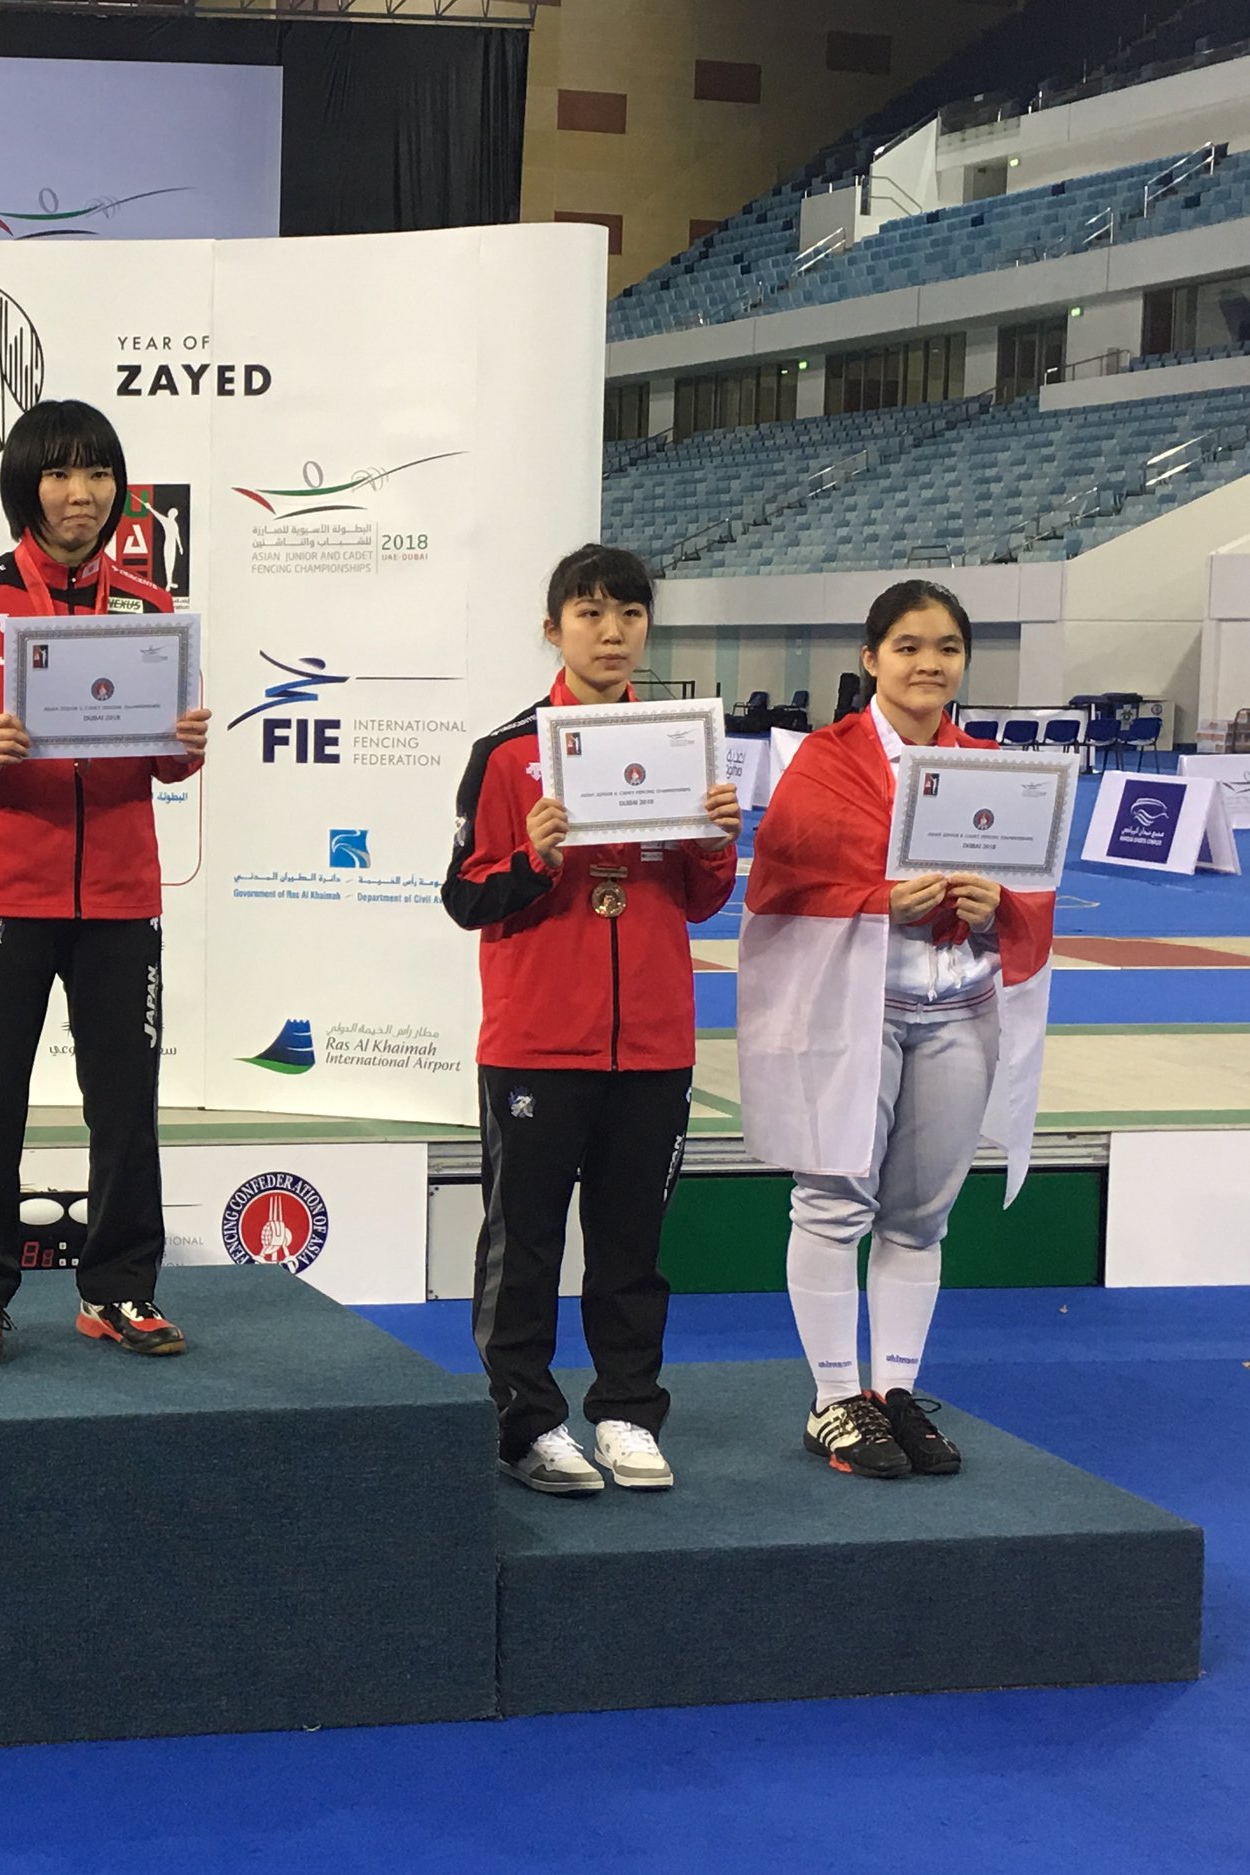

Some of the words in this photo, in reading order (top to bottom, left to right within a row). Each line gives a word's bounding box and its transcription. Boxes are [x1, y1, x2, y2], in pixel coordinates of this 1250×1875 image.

[117, 336, 172, 351] YEAR
[183, 335, 210, 350] OF
[116, 363, 272, 397] ZAYED
[381, 534, 429, 550] 2018
[251, 551, 281, 562] ASIAN
[284, 551, 318, 562] JUNIOR
[320, 551, 341, 561] AND
[342, 550, 373, 561] CADET
[251, 564, 292, 574] FENCING
[294, 563, 372, 573] CHAMPIONSHIPS
[353, 719, 467, 733] INTERNATIONAL
[262, 718, 341, 764] FIE
[353, 737, 420, 749] FENCING
[353, 754, 441, 766] FEDERATION
[277, 889, 285, 898] of
[286, 890, 300, 899] Ras
[301, 890, 309, 899] Al
[357, 892, 404, 903] Department
[406, 894, 412, 903] of
[413, 894, 432, 904] Civil
[144, 965, 158, 1049] JAPAN
[326, 1036, 350, 1051] Ras
[354, 1037, 369, 1052] Al
[372, 1039, 437, 1056] Khaimah
[325, 1051, 410, 1068] International
[413, 1057, 462, 1073] Airport
[229, 1173, 325, 1215] CONFEDERATION
[312, 1215, 327, 1234] OF
[224, 1210, 250, 1265] FENCING
[298, 1233, 324, 1265] ASIA
